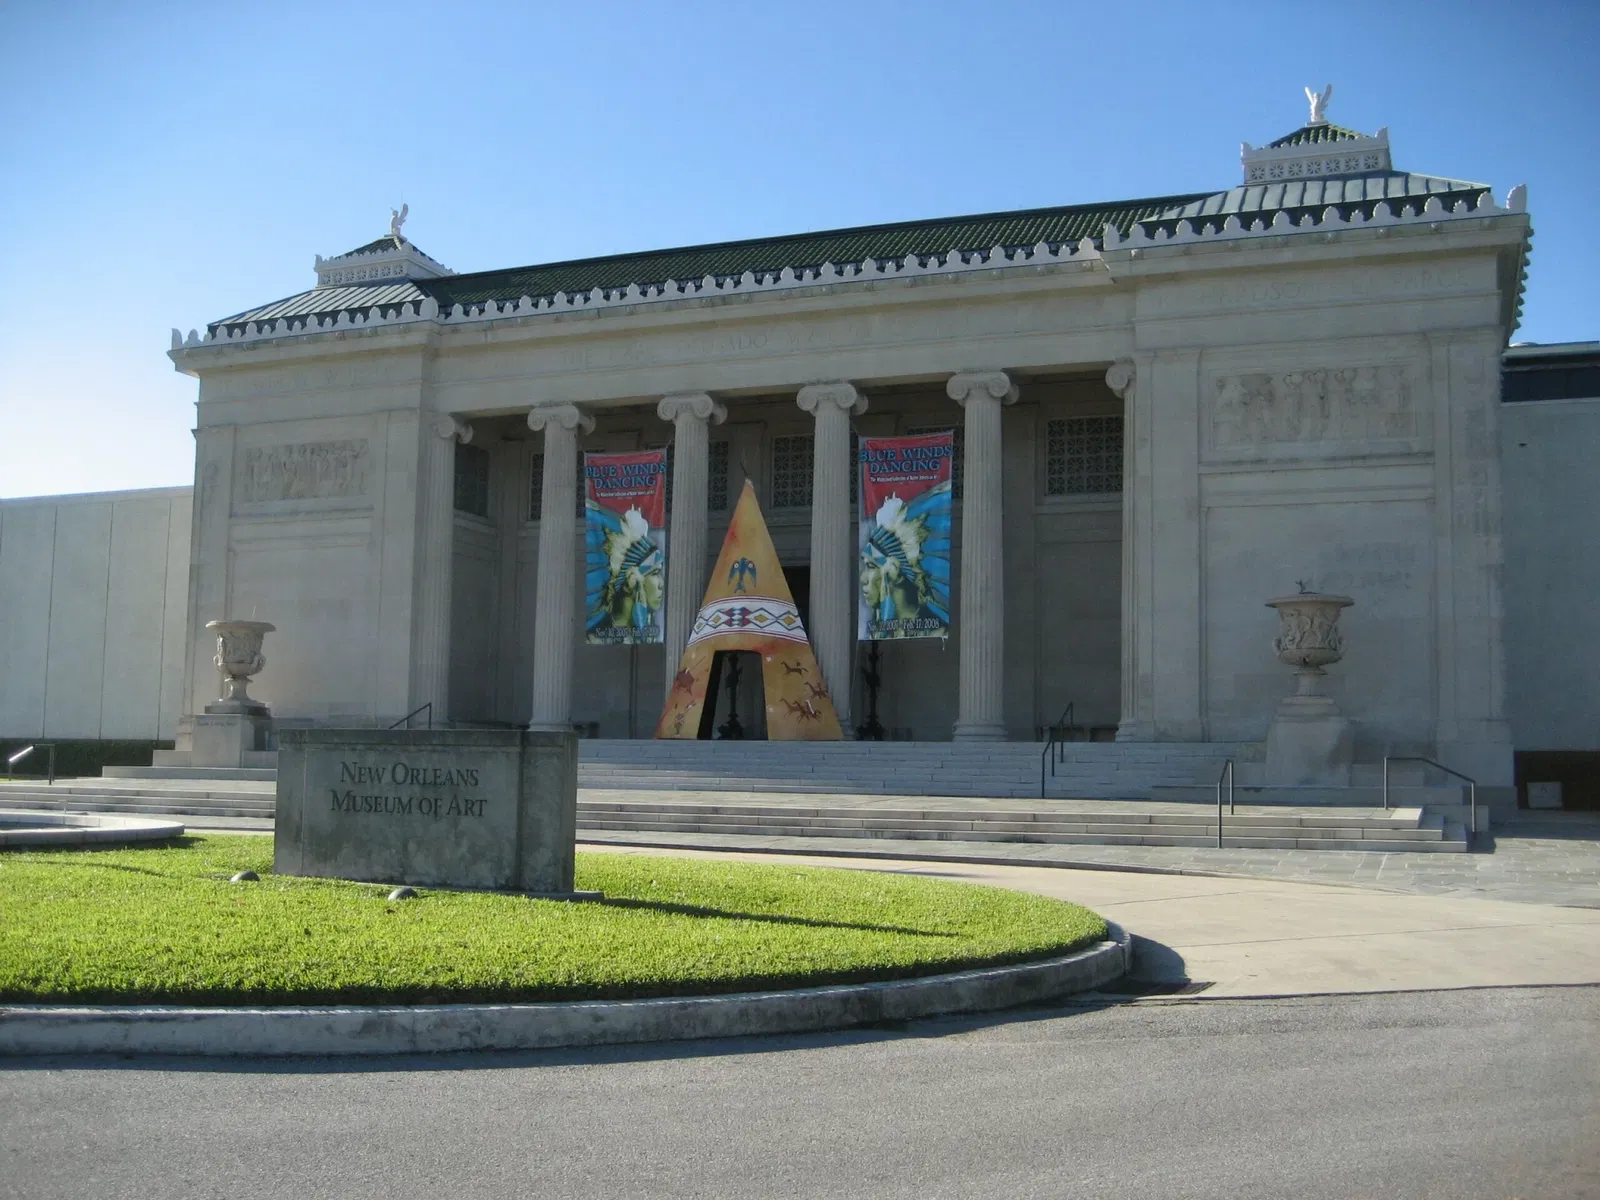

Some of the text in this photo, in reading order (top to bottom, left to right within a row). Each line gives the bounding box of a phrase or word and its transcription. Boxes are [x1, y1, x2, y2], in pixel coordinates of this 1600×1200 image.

[860, 445, 952, 462] BLUE WINDS
[584, 462, 667, 478] BLUE WINDS
[870, 459, 941, 474] DANCING
[595, 475, 657, 489] DANCING
[924, 617, 939, 629] 2008
[340, 761, 479, 787] NEW ORLEANS
[329, 788, 414, 815] MUSEUM
[446, 793, 488, 817] ART
